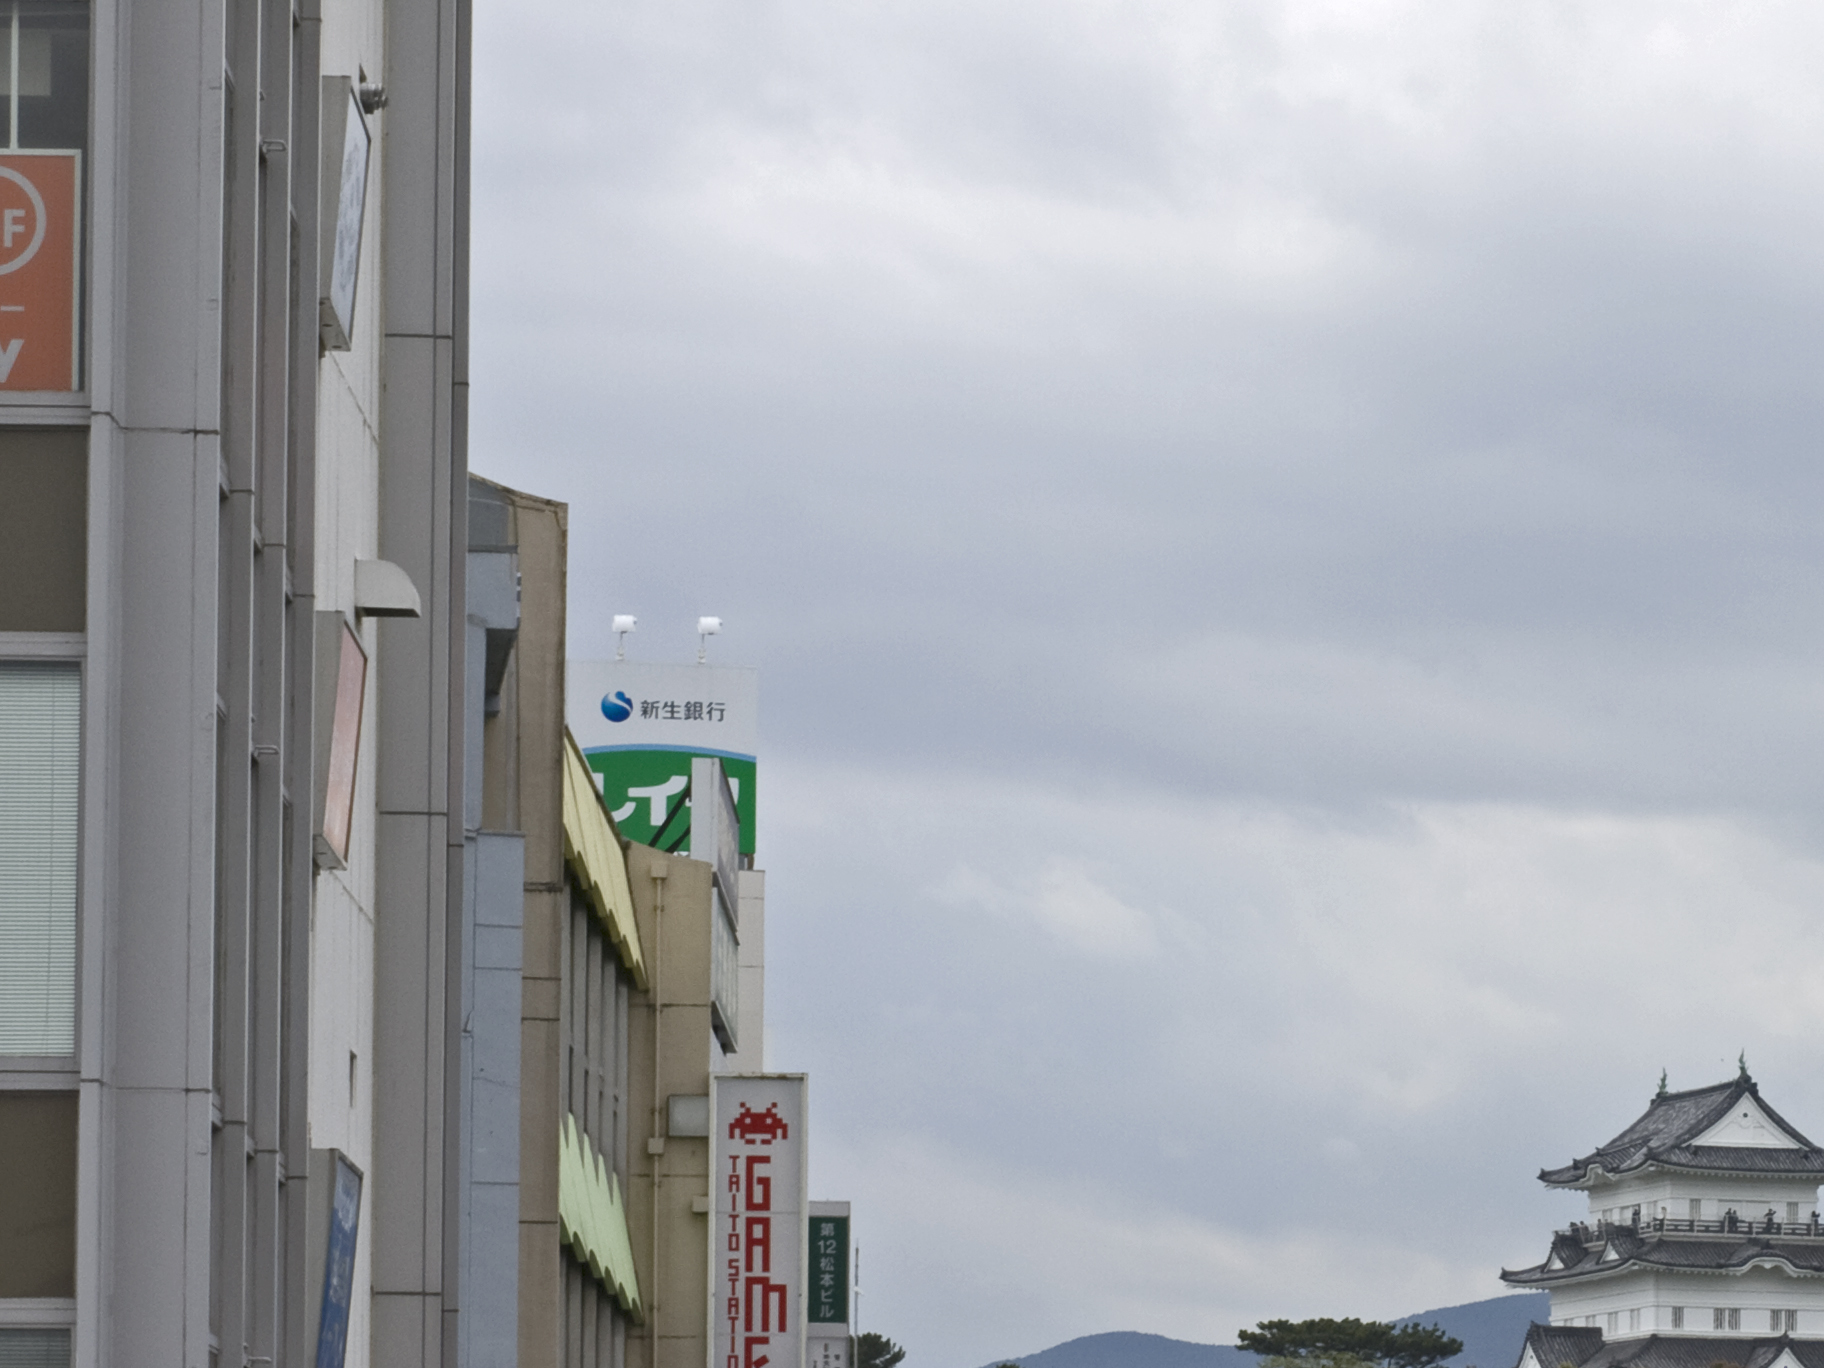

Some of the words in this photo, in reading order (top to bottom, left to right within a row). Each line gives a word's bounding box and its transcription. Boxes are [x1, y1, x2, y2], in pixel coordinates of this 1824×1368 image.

[640, 699, 727, 723] 新生銀行
[728, 1155, 740, 1252] TAITO
[817, 1222, 837, 1319] 第12松本ビル
